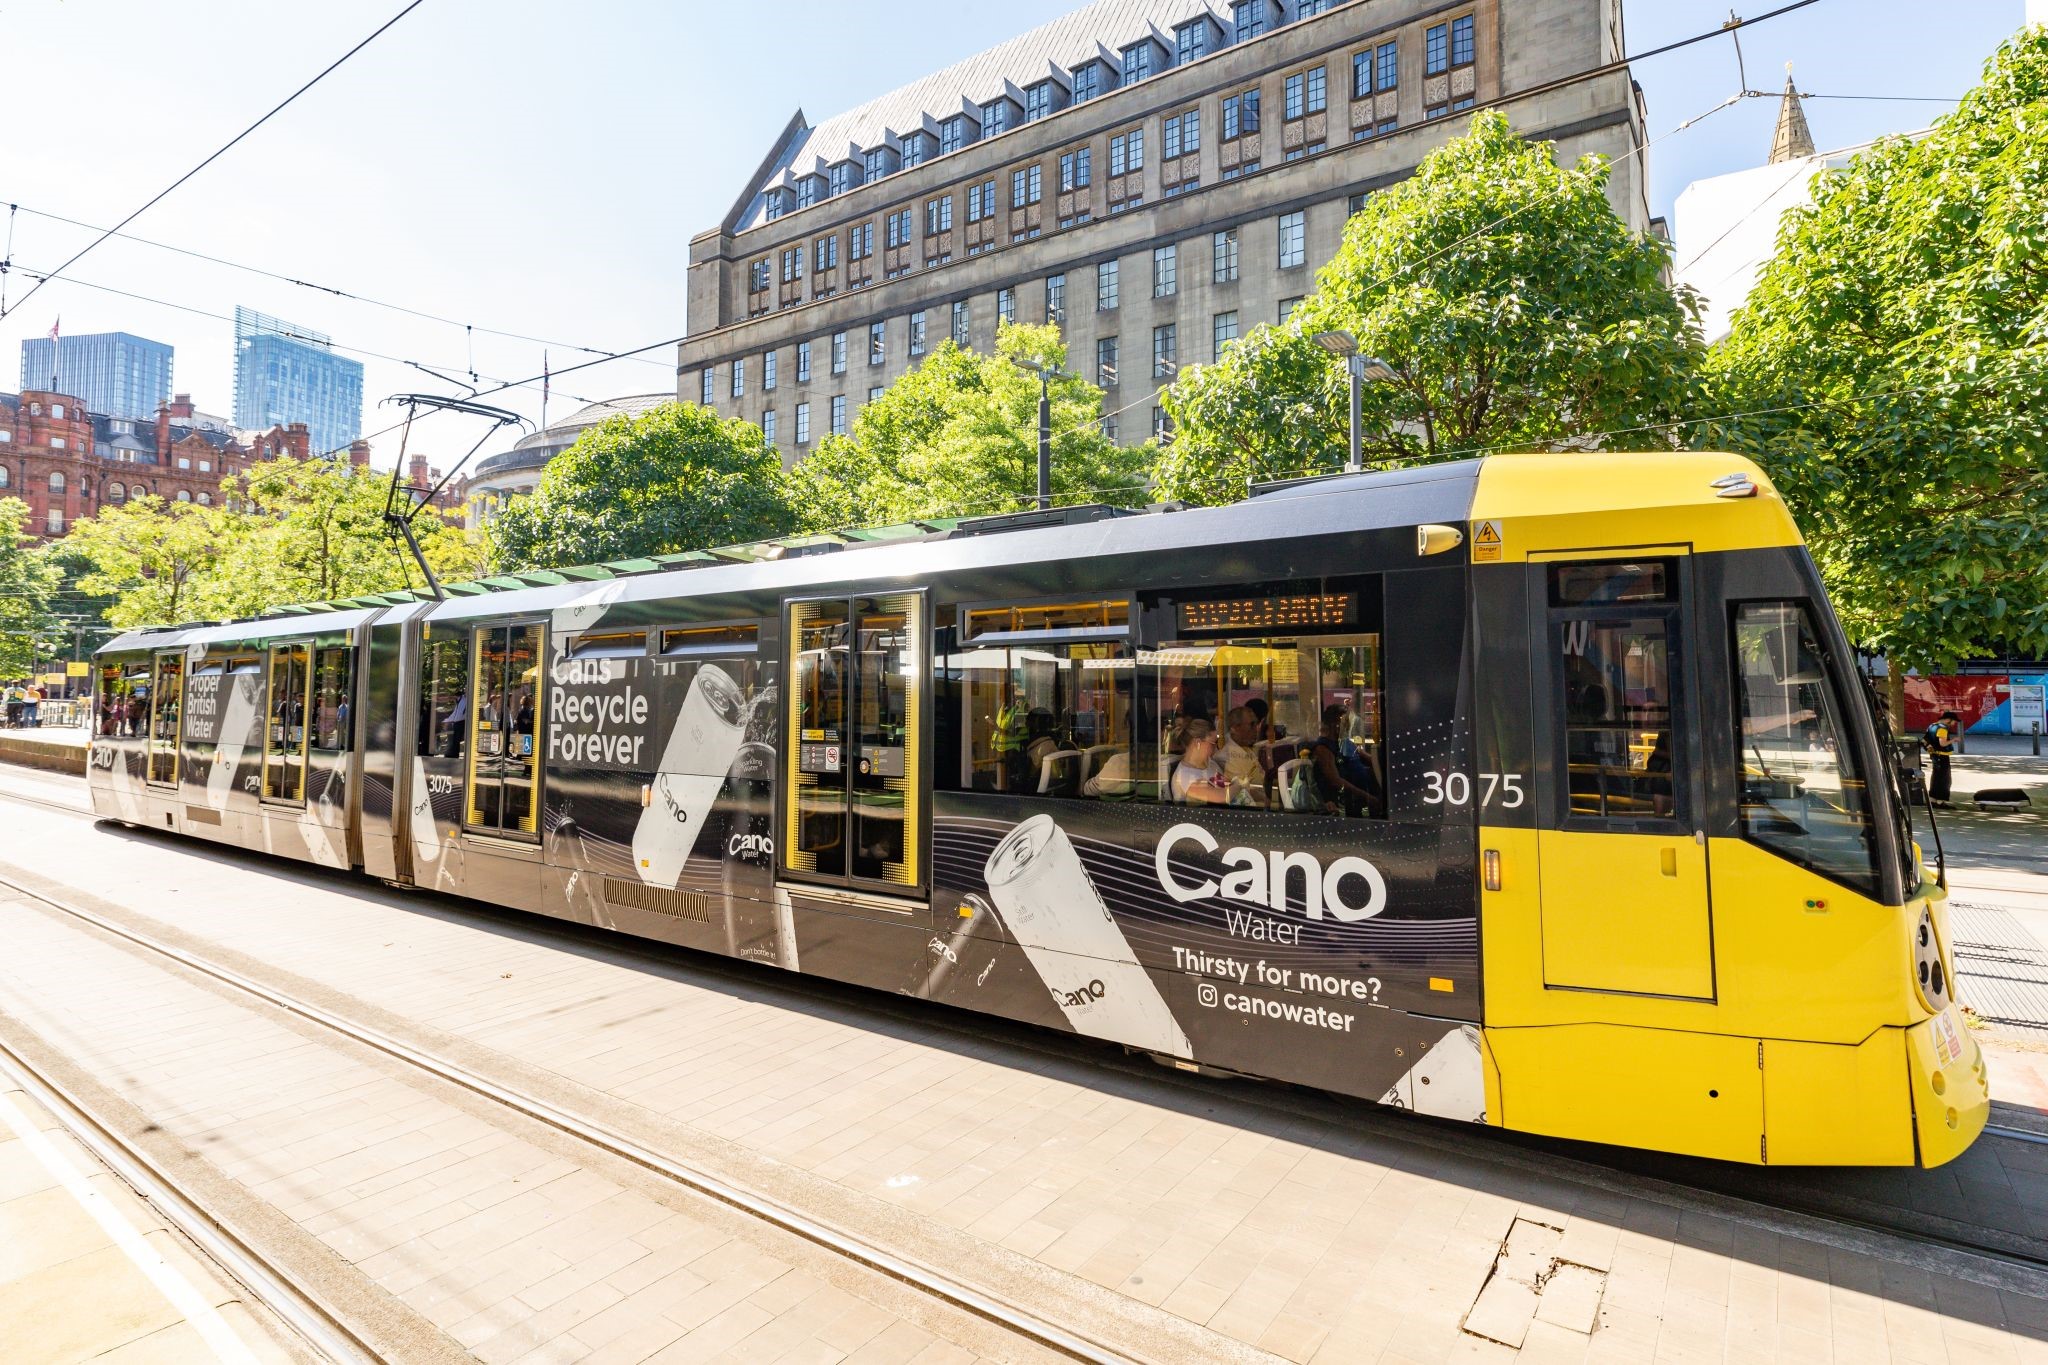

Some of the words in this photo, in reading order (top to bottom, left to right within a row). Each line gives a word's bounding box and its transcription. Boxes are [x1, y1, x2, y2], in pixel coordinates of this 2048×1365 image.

[552, 651, 612, 685] Cans
[188, 675, 221, 699] Proper
[187, 693, 216, 716] British
[551, 686, 648, 732] Recycle
[186, 715, 214, 739] Water
[549, 724, 644, 765] Forever
[429, 774, 452, 794] 3075
[659, 772, 687, 823] Cano
[729, 833, 774, 856] Cano
[1155, 823, 1387, 922] Cano
[1225, 908, 1303, 945] Water
[928, 937, 957, 963] Cano
[977, 958, 996, 986] Cano
[1172, 946, 1249, 985] Thirsty
[1257, 960, 1292, 986] for
[1300, 970, 1382, 1002] more?
[1052, 979, 1105, 1007] Cano
[1223, 993, 1355, 1032] canowater
